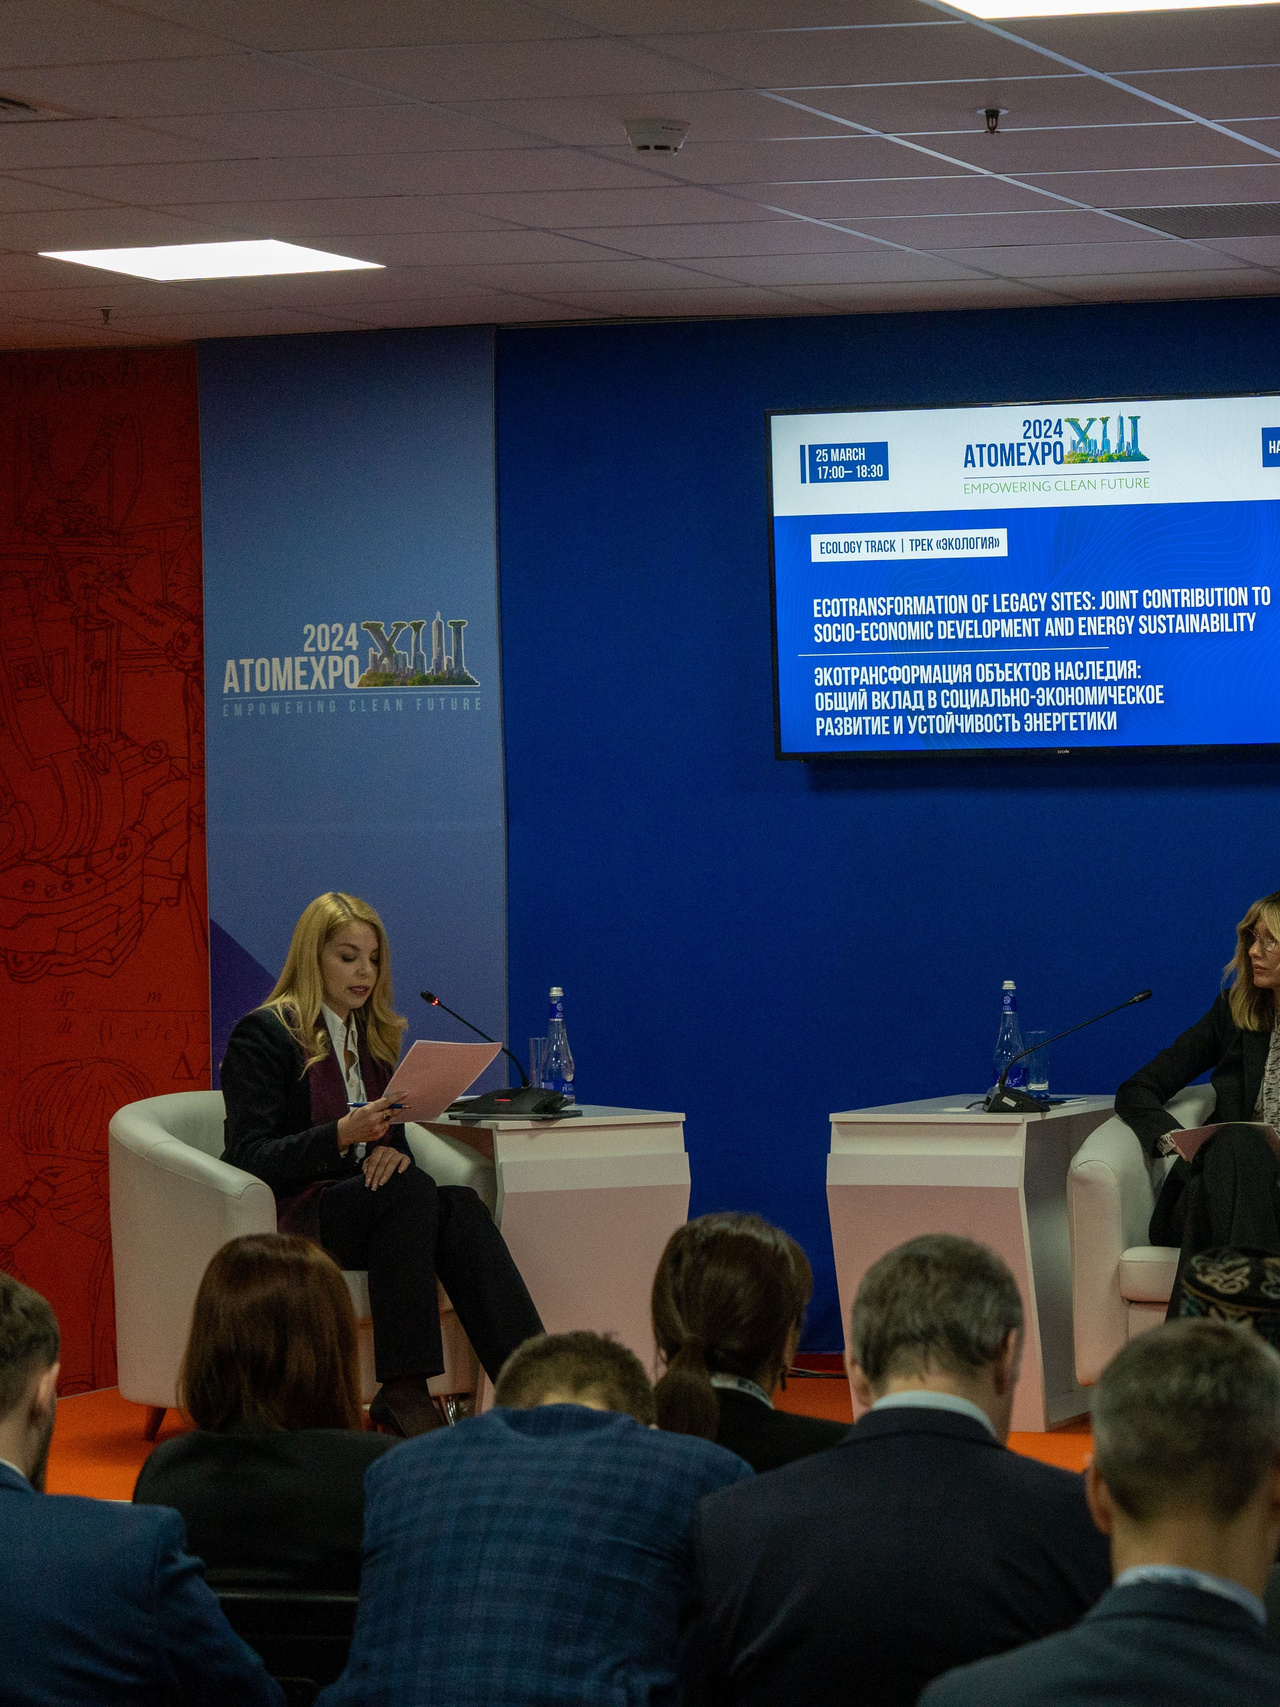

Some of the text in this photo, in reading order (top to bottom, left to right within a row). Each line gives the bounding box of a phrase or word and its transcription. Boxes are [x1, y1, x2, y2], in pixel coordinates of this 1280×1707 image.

[1022, 418, 1064, 440] 2024
[815, 447, 866, 463] 25 MARCH
[963, 440, 1064, 468] ATOMEXPO
[856, 464, 884, 478] 18:30
[963, 477, 1150, 495] EMPOWERING CLEAN FUTURE
[820, 539, 896, 554] ECOLOGY TRACK
[909, 536, 1000, 552] ТРЕК «ЭКОЛОГИЯ»
[813, 586, 1271, 618] ECOTRANSFORMATION OF LEGACY SITES: JOINT CONTRIBUTION TO
[303, 623, 359, 652] 2024
[814, 612, 1257, 643] SOCIO-ECONOMIC DEVELOPMENT AND ENERGY SUSTAINABILITY
[223, 655, 360, 694] ATOMEXPO
[814, 659, 1142, 687] ЭКОТРАНСФОРМАЦИЯ ОБЪЕКТОВ НАСЛЕДИЯ:
[223, 697, 482, 717] EMPOWERING CLEAN FUTURE
[815, 684, 1165, 713] ОБЩИЙ ВКЛАД В СОЦИАЛЬНО-ЭКОНОМИЧЕСКОЕ
[816, 710, 1118, 736] РАЗВИТИЕ И УСТОЙЧИВОСТЬ ЭНЕРГЕТИКИ
